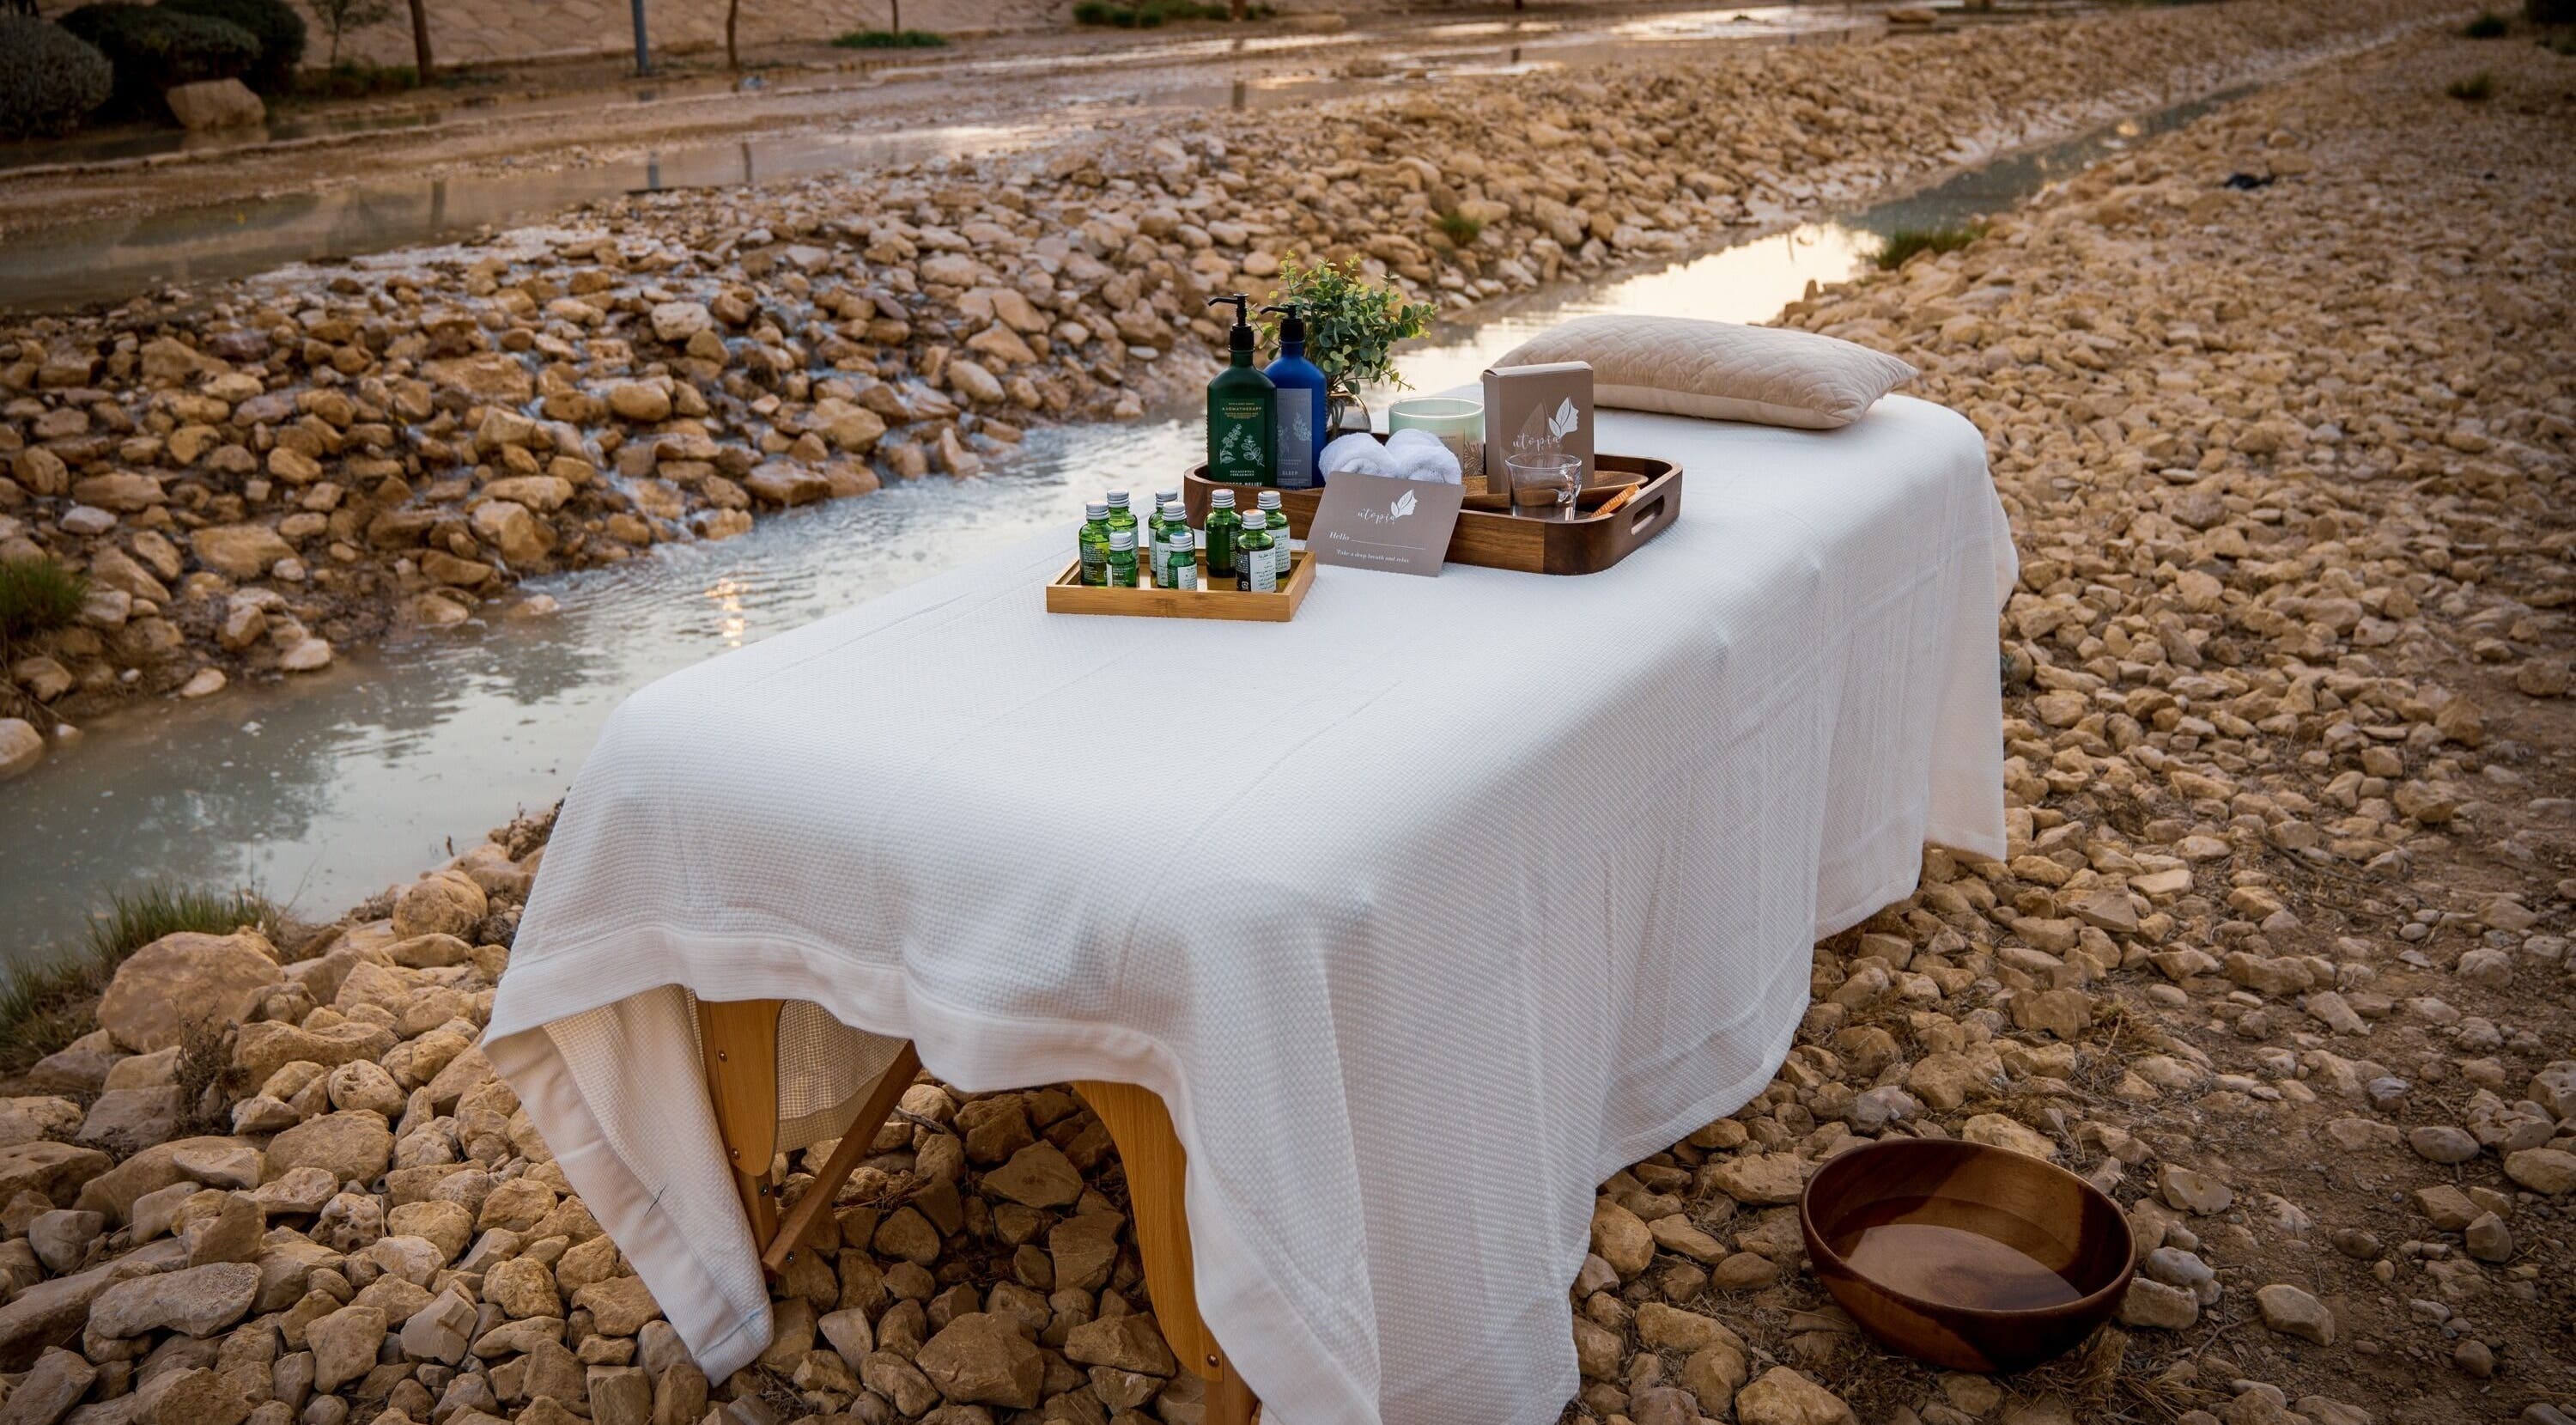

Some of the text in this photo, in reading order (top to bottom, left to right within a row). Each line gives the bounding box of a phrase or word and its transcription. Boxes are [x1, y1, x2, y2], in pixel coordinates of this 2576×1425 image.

[1513, 433, 1561, 453] utopia
[1358, 508, 1395, 525] utopia
[1329, 532, 1350, 541] Hello
[1354, 551, 1367, 560] deep
